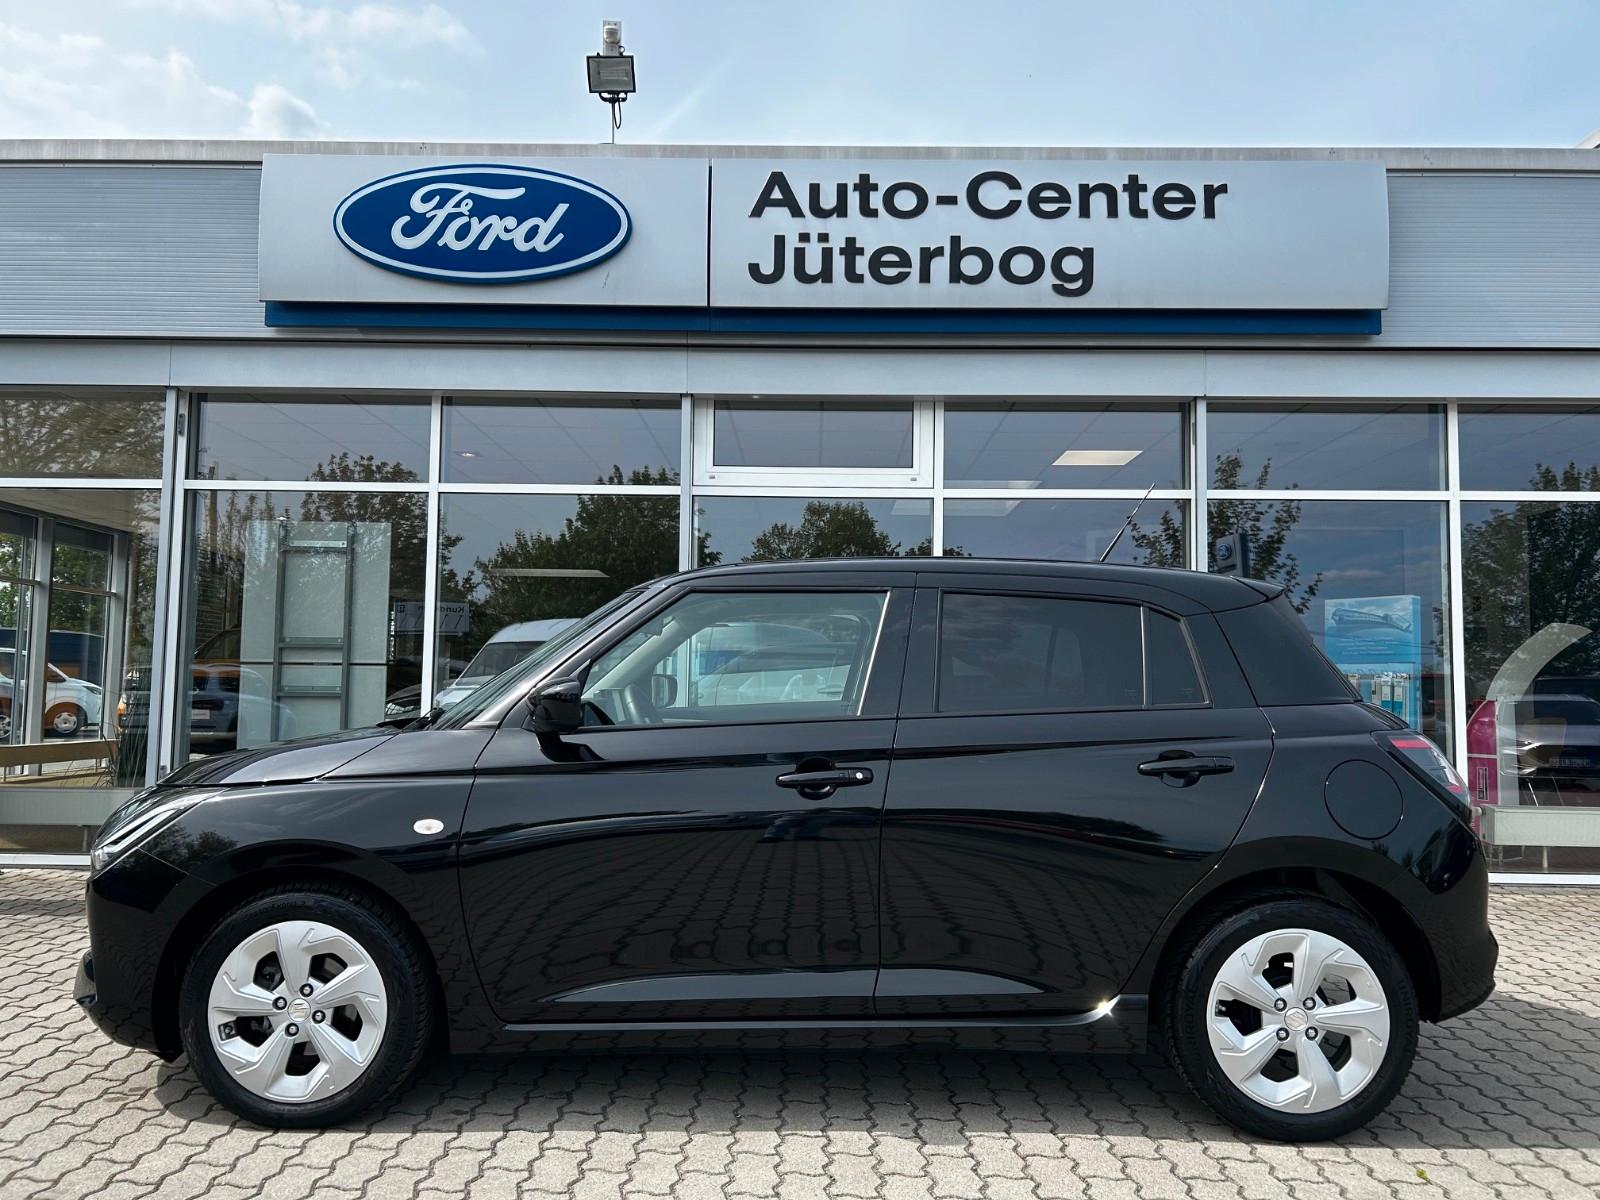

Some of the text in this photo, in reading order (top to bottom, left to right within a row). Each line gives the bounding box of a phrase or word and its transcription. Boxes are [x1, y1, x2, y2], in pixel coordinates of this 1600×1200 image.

[391, 182, 570, 253] Ford
[748, 170, 1228, 220] Auto-Center
[748, 232, 1095, 297] Jüterbog
